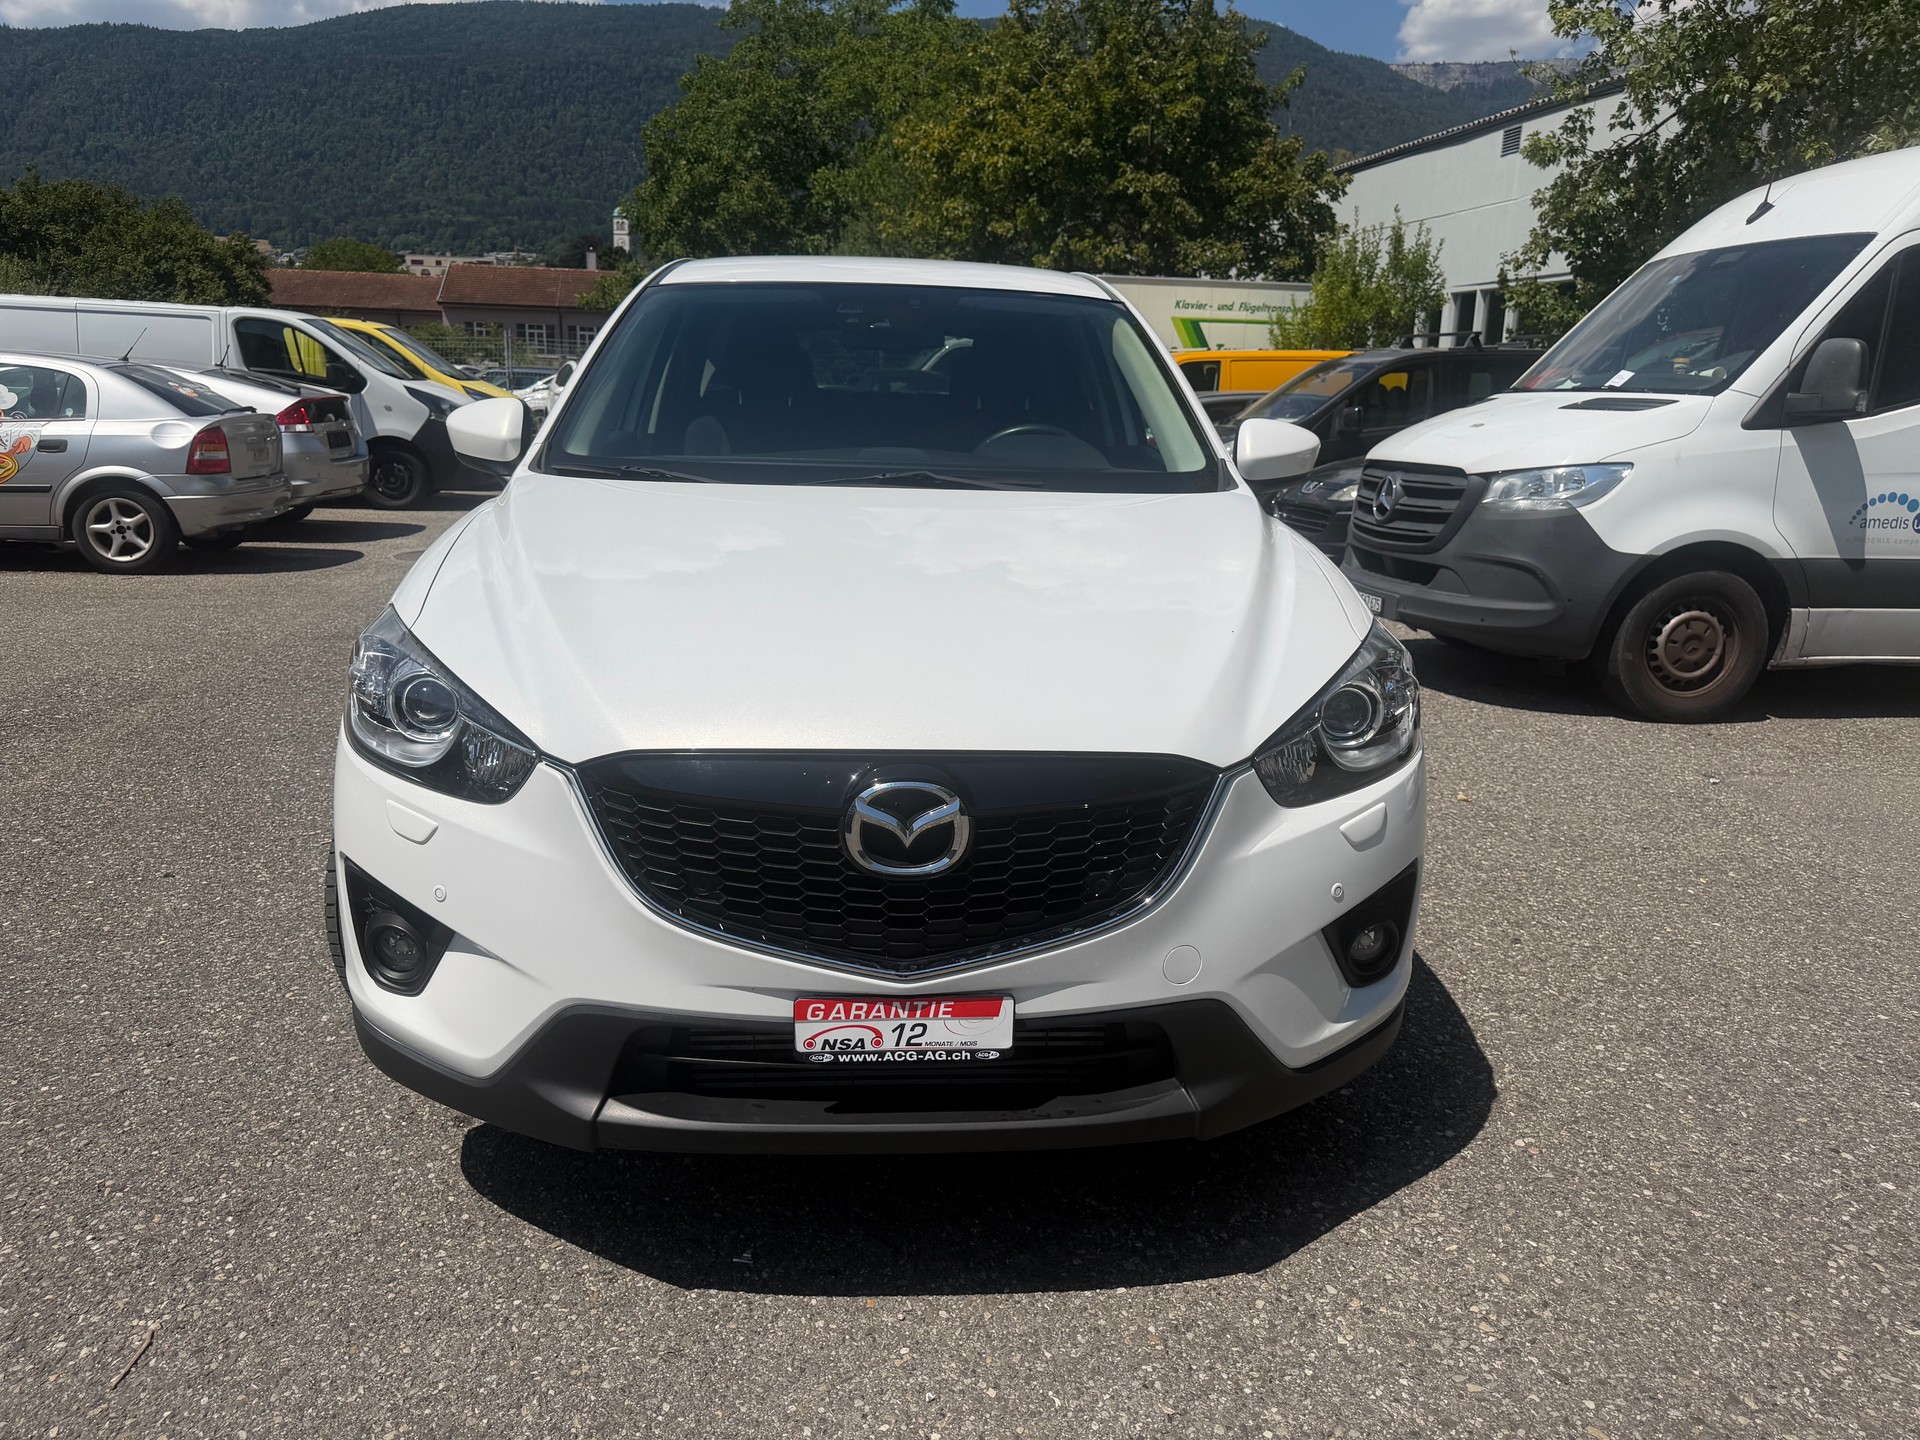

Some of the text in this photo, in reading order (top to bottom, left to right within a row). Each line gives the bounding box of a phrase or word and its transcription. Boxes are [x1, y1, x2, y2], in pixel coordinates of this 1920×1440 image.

[1217, 301, 1235, 311] und
[1238, 302, 1292, 315] Flügeltransp
[1860, 516, 1909, 529] amedis
[806, 1001, 955, 1021] GARANTIE
[891, 1022, 928, 1047] 12
[820, 1037, 866, 1051] NSA
[837, 1050, 971, 1062] www.ACG-AG.ch
